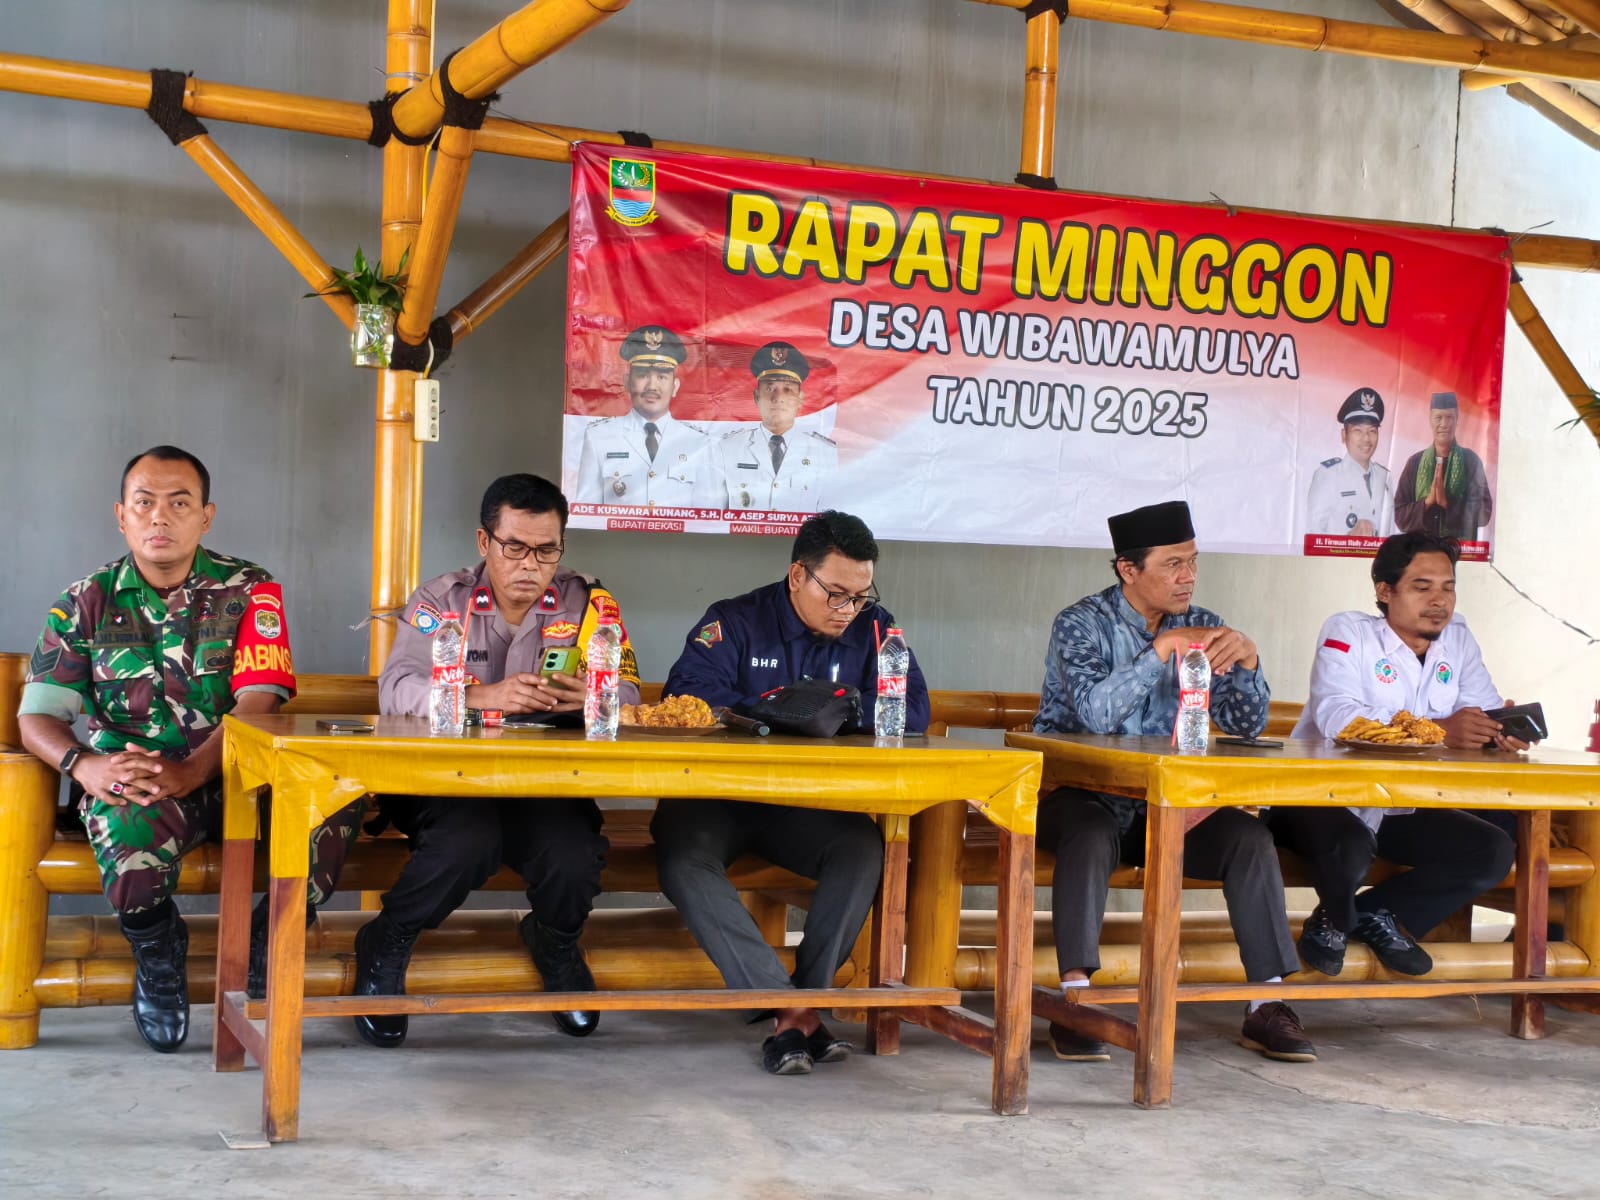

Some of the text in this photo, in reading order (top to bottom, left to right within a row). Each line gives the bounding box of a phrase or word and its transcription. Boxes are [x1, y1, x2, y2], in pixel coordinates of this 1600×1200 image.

[724, 191, 1393, 327] RAPAT MINGGON
[828, 299, 1299, 379] DESA WIBAWAMULYA
[928, 376, 1208, 437] TAHUN 2025
[572, 505, 720, 519] ADE KUSWARA KUNANG, S.H.
[723, 511, 737, 520] dr.
[739, 512, 765, 521] ASEP
[767, 513, 799, 522] SURYA
[610, 520, 683, 531] BUPATI BEKASI
[731, 525, 798, 535] WAKIL BUPATI
[751, 656, 778, 668] BHR
